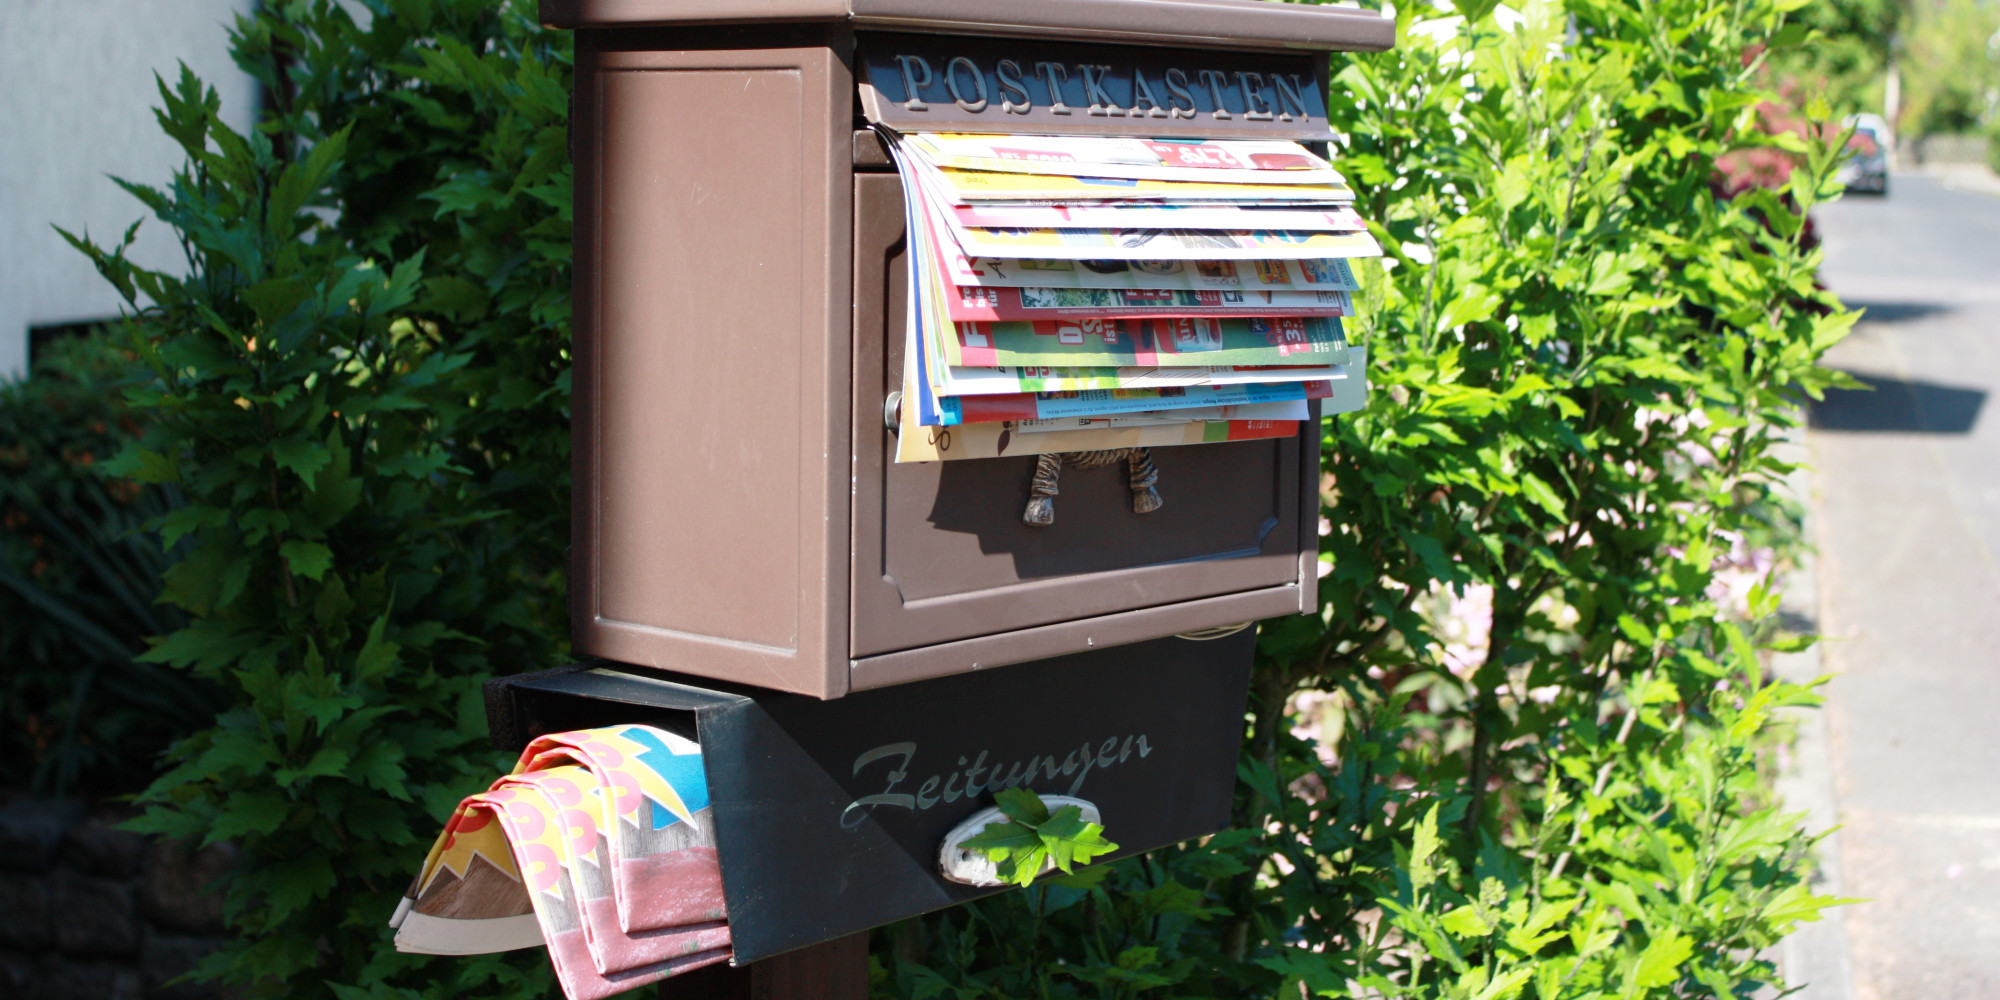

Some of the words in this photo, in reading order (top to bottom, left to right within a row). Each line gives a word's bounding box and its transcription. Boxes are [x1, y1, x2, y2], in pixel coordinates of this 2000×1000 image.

[899, 54, 1309, 122] POSTKASTEN
[975, 288, 987, 308] bis
[987, 288, 999, 308] für
[840, 733, 1152, 829] Zeitungen
